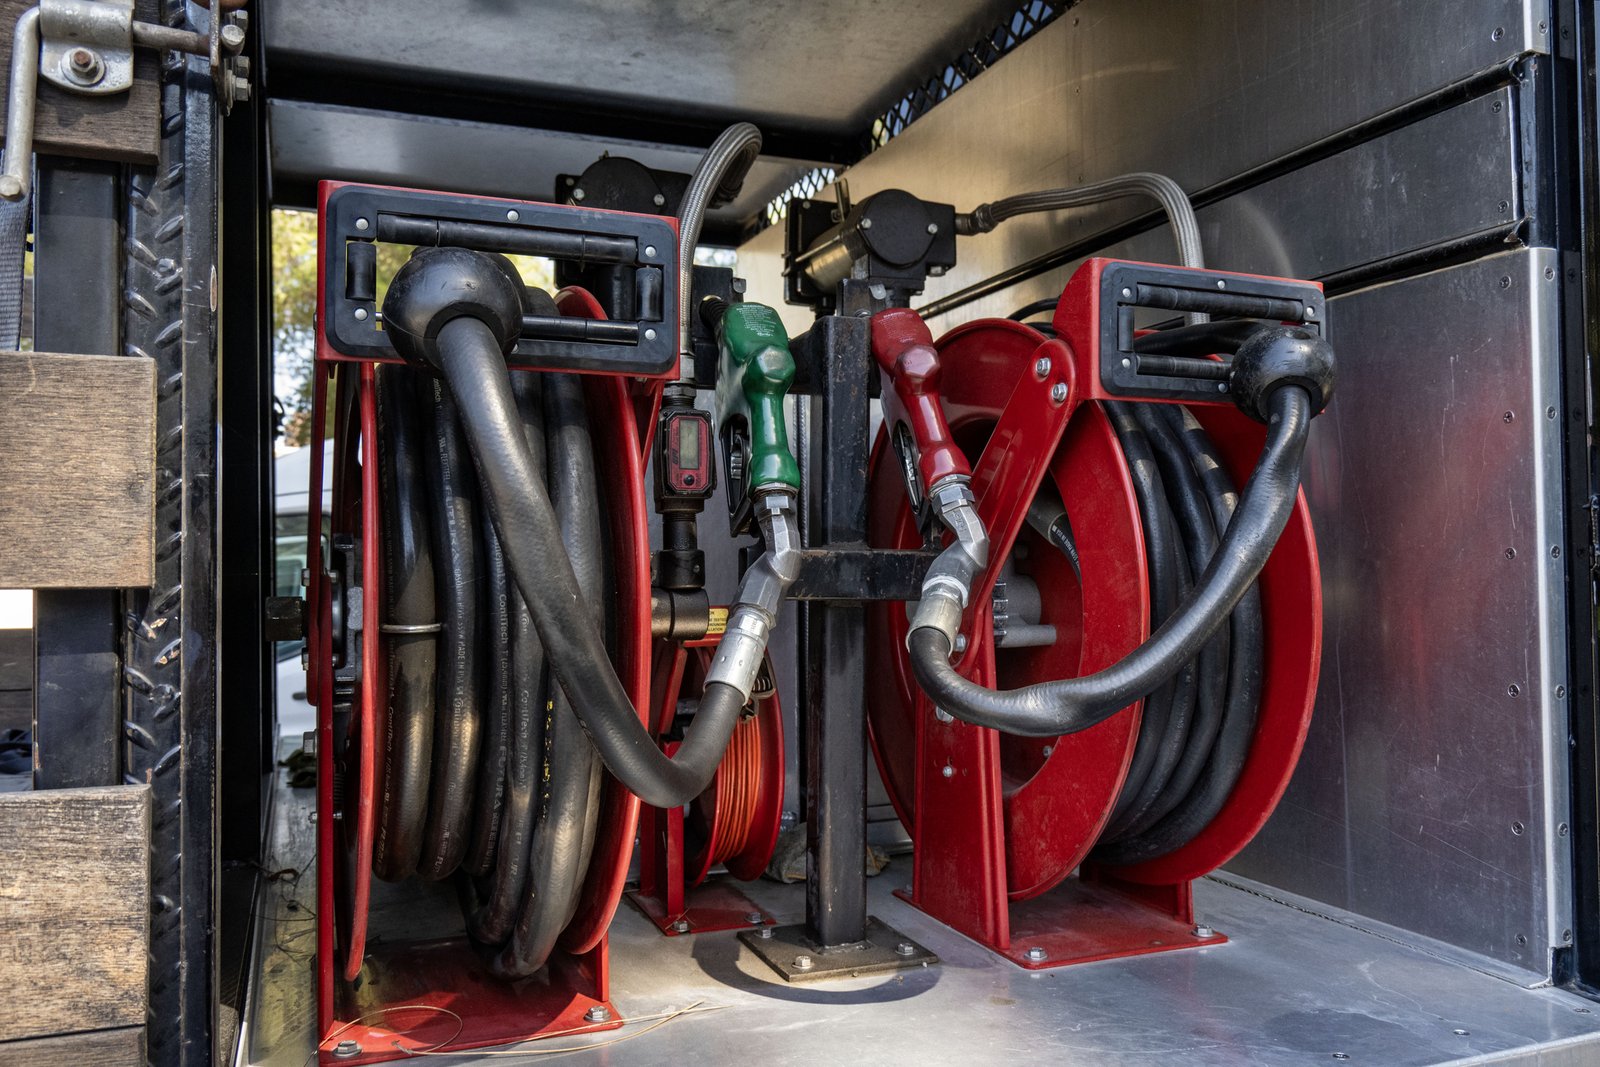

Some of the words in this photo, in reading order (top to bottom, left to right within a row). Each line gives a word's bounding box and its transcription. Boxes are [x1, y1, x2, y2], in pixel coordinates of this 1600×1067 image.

[499, 593, 509, 644] ContiTech
[457, 641, 466, 660] MADE
[387, 706, 395, 752] ContiTech
[520, 689, 530, 740] ContiTech
[493, 745, 508, 811] FUTURA
